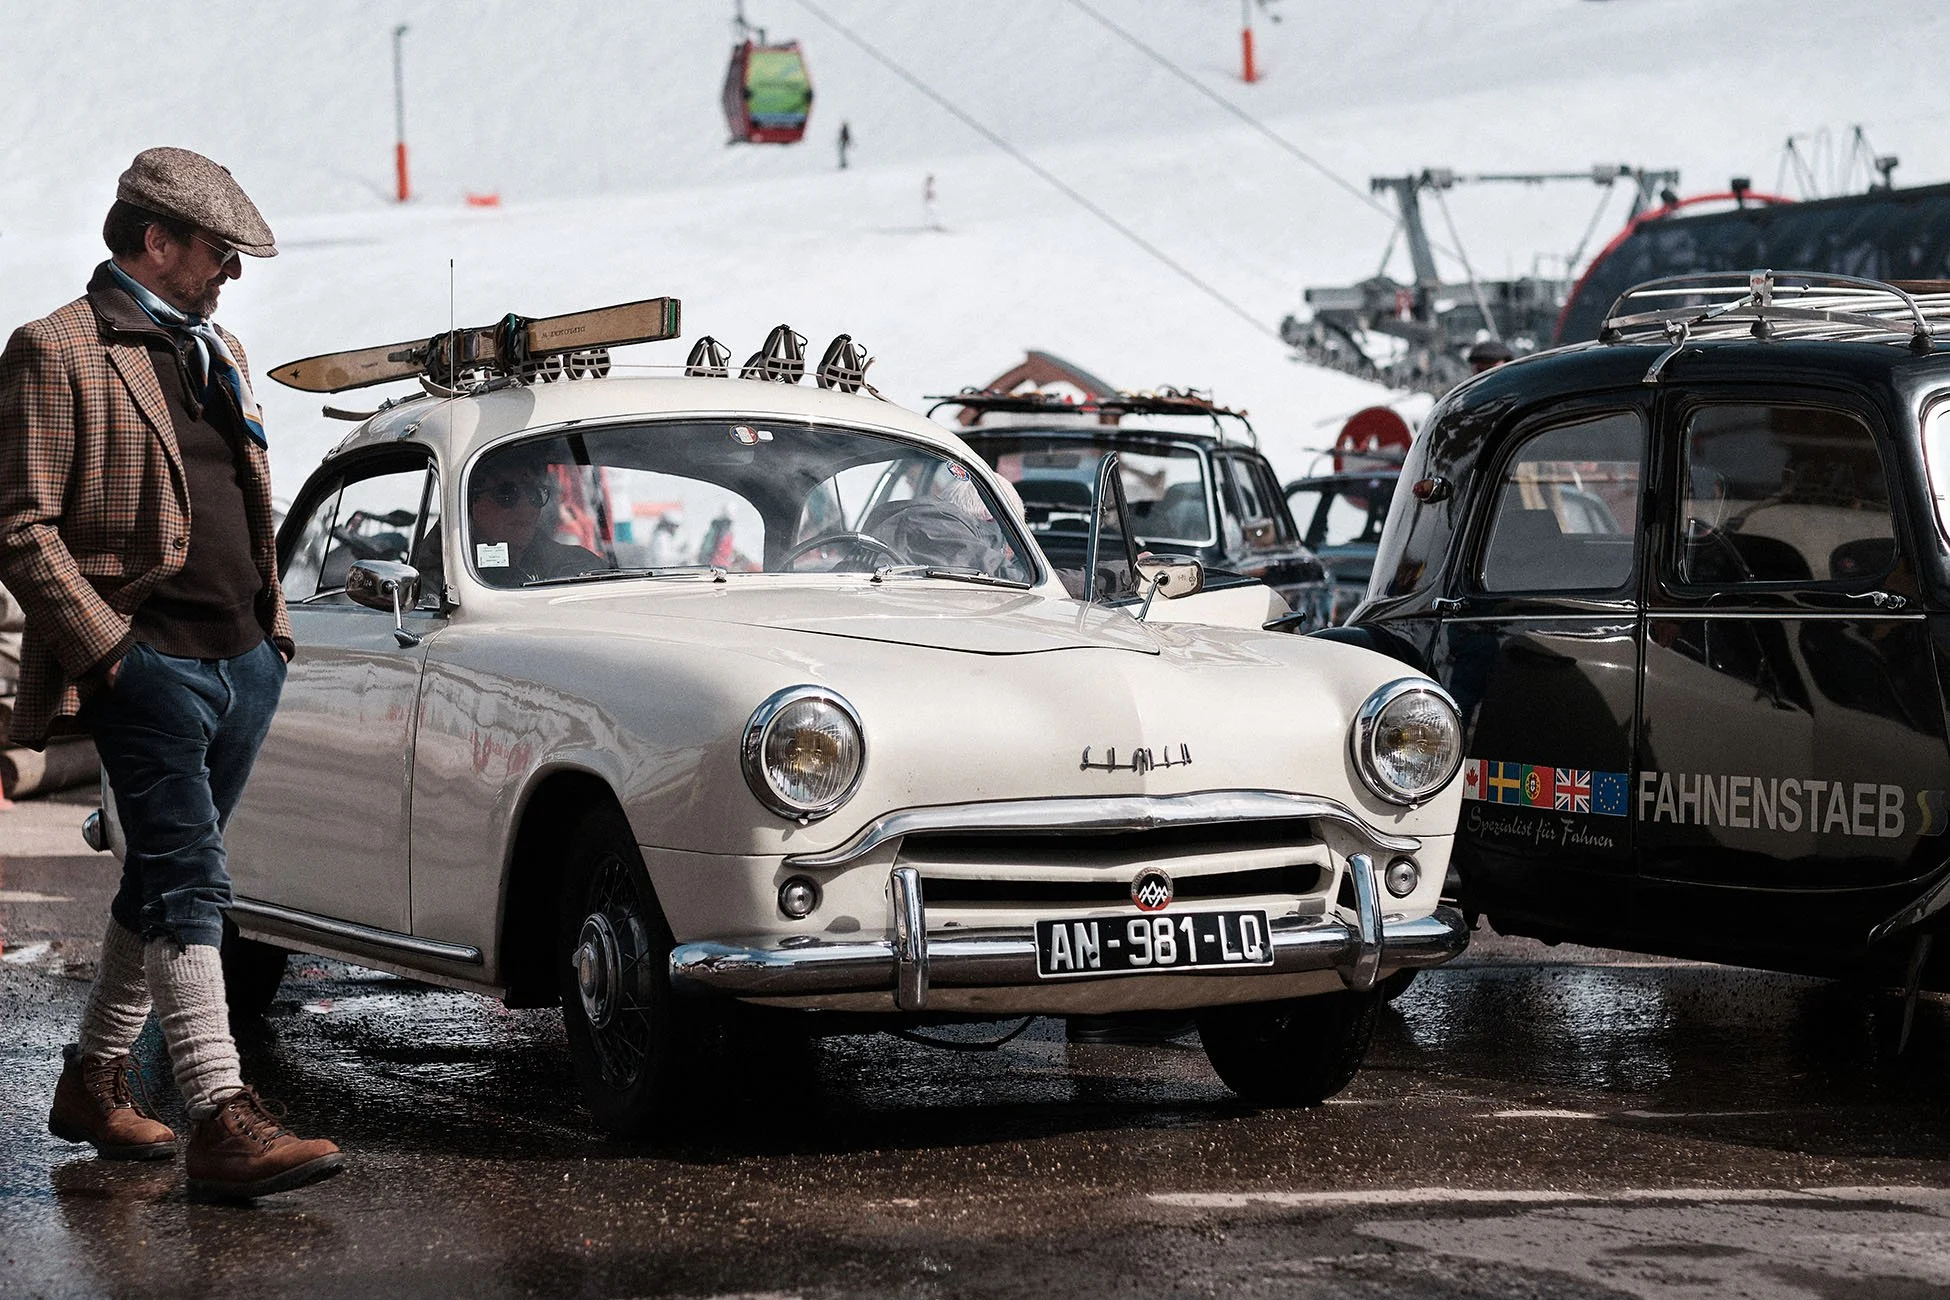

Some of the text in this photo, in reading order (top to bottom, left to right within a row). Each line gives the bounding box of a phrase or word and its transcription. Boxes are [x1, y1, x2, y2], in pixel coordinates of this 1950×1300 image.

[1467, 805, 1614, 848] Spezialist für Fahnen
[1638, 770, 1905, 838] FAHNENSTAEB
[1050, 914, 1265, 972] AN-981-LQ
